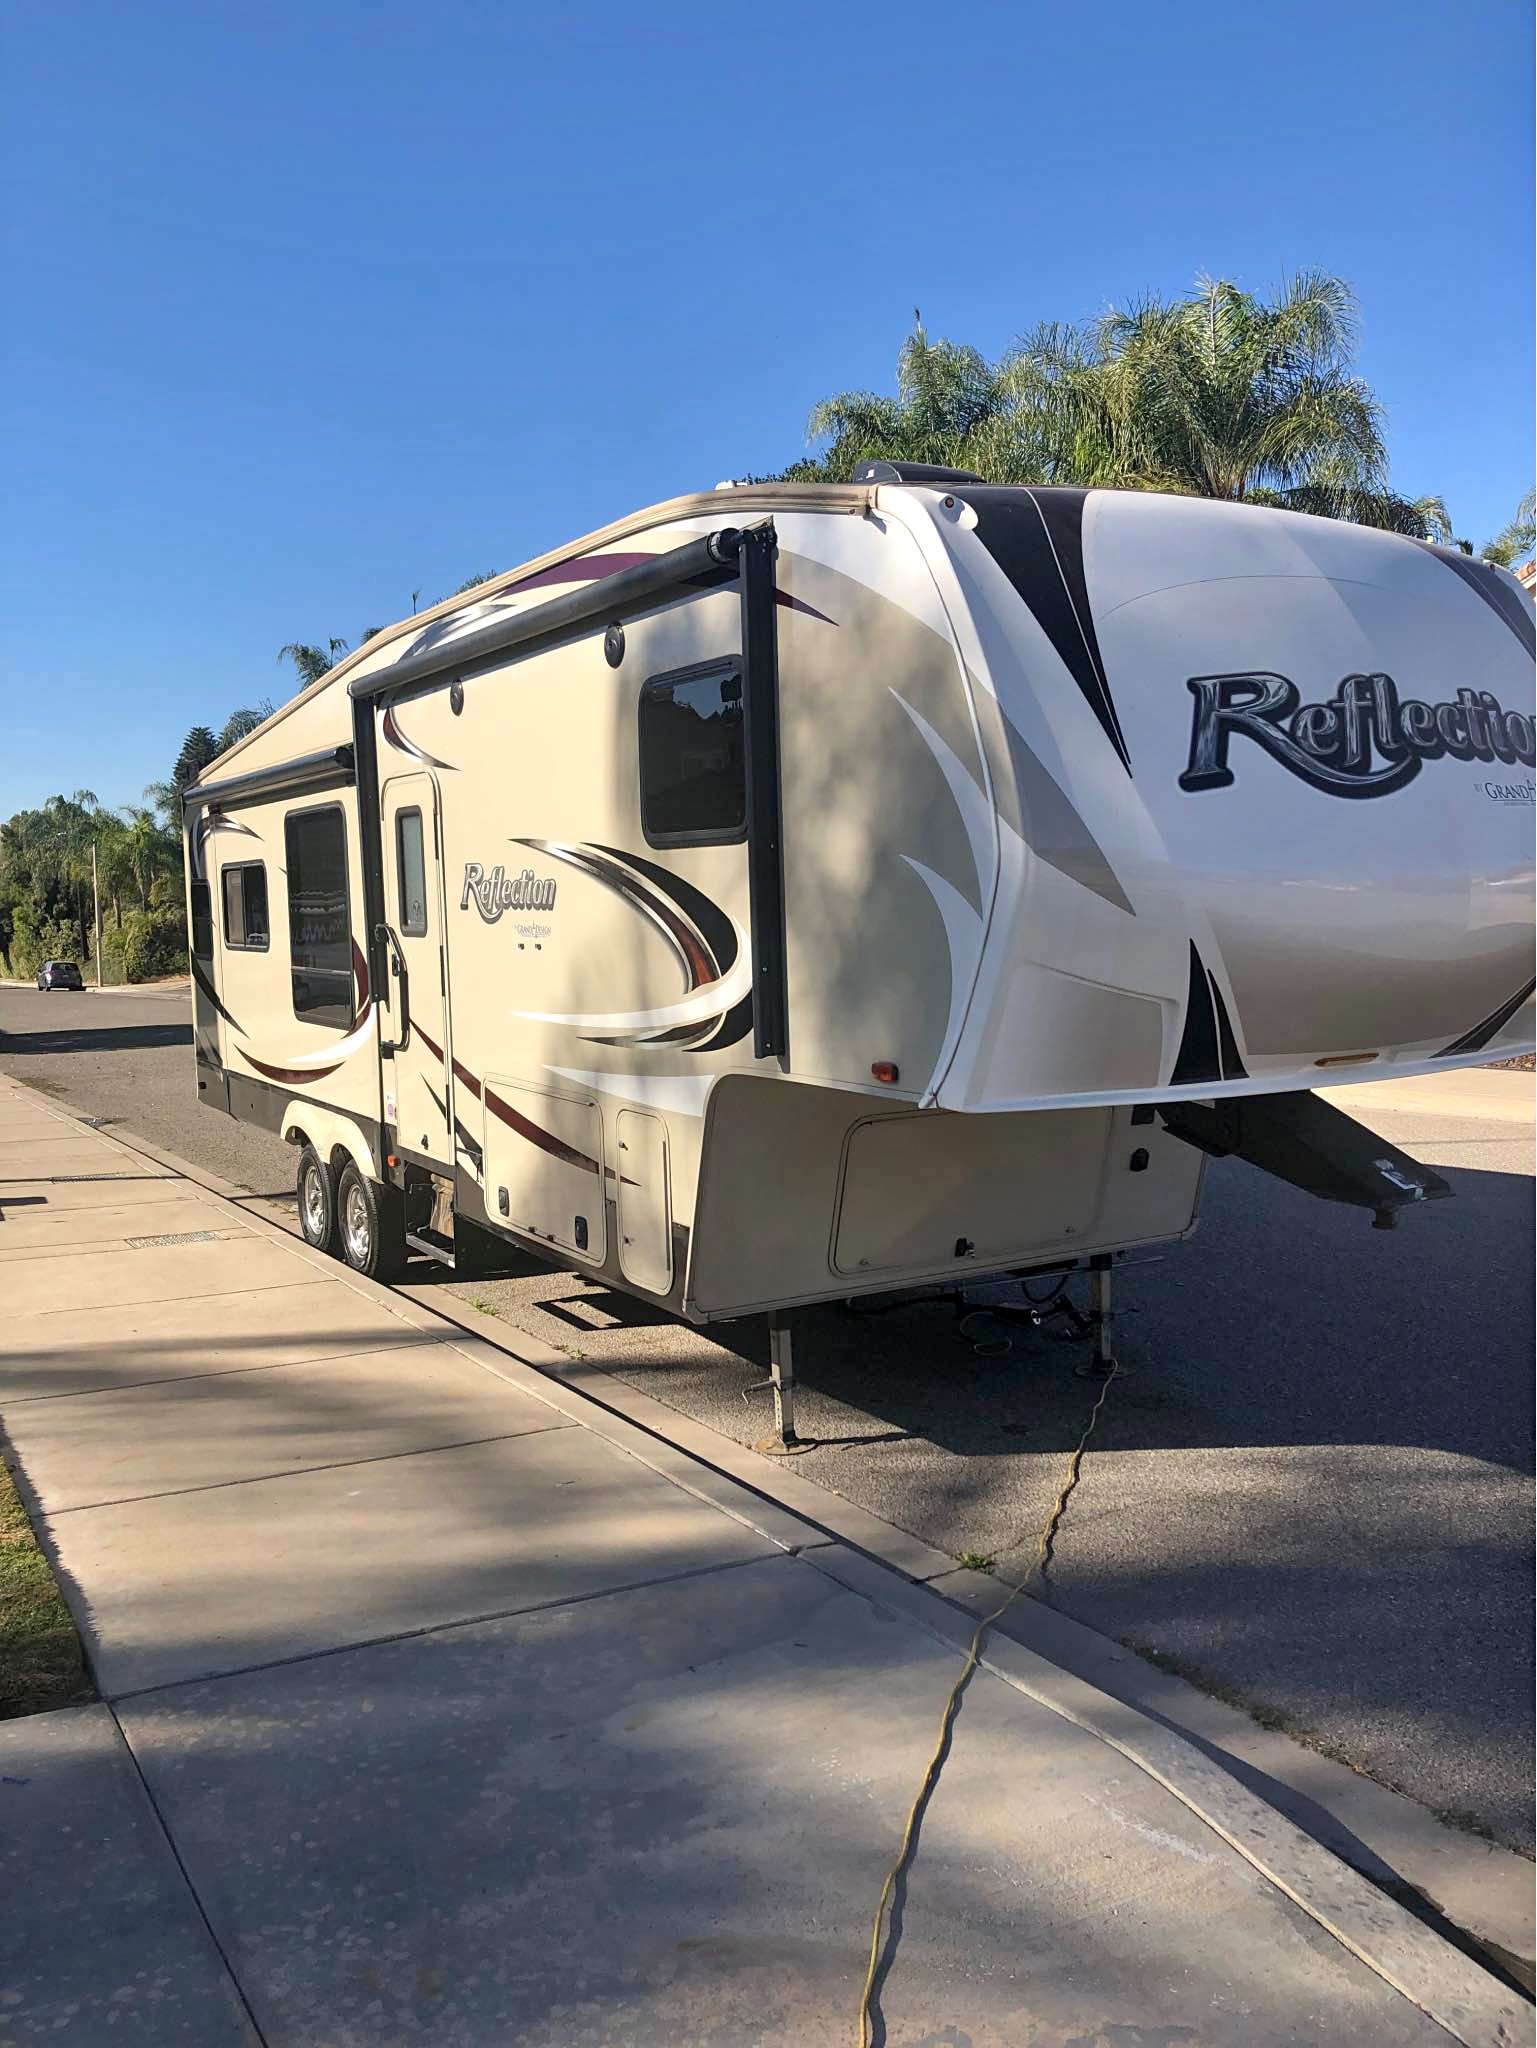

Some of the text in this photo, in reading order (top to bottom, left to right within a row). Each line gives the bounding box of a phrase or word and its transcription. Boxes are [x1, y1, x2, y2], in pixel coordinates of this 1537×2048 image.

[1178, 671, 1536, 800] Reflectio
[1485, 782, 1529, 799] GRAND
[460, 863, 556, 924] Reflection
